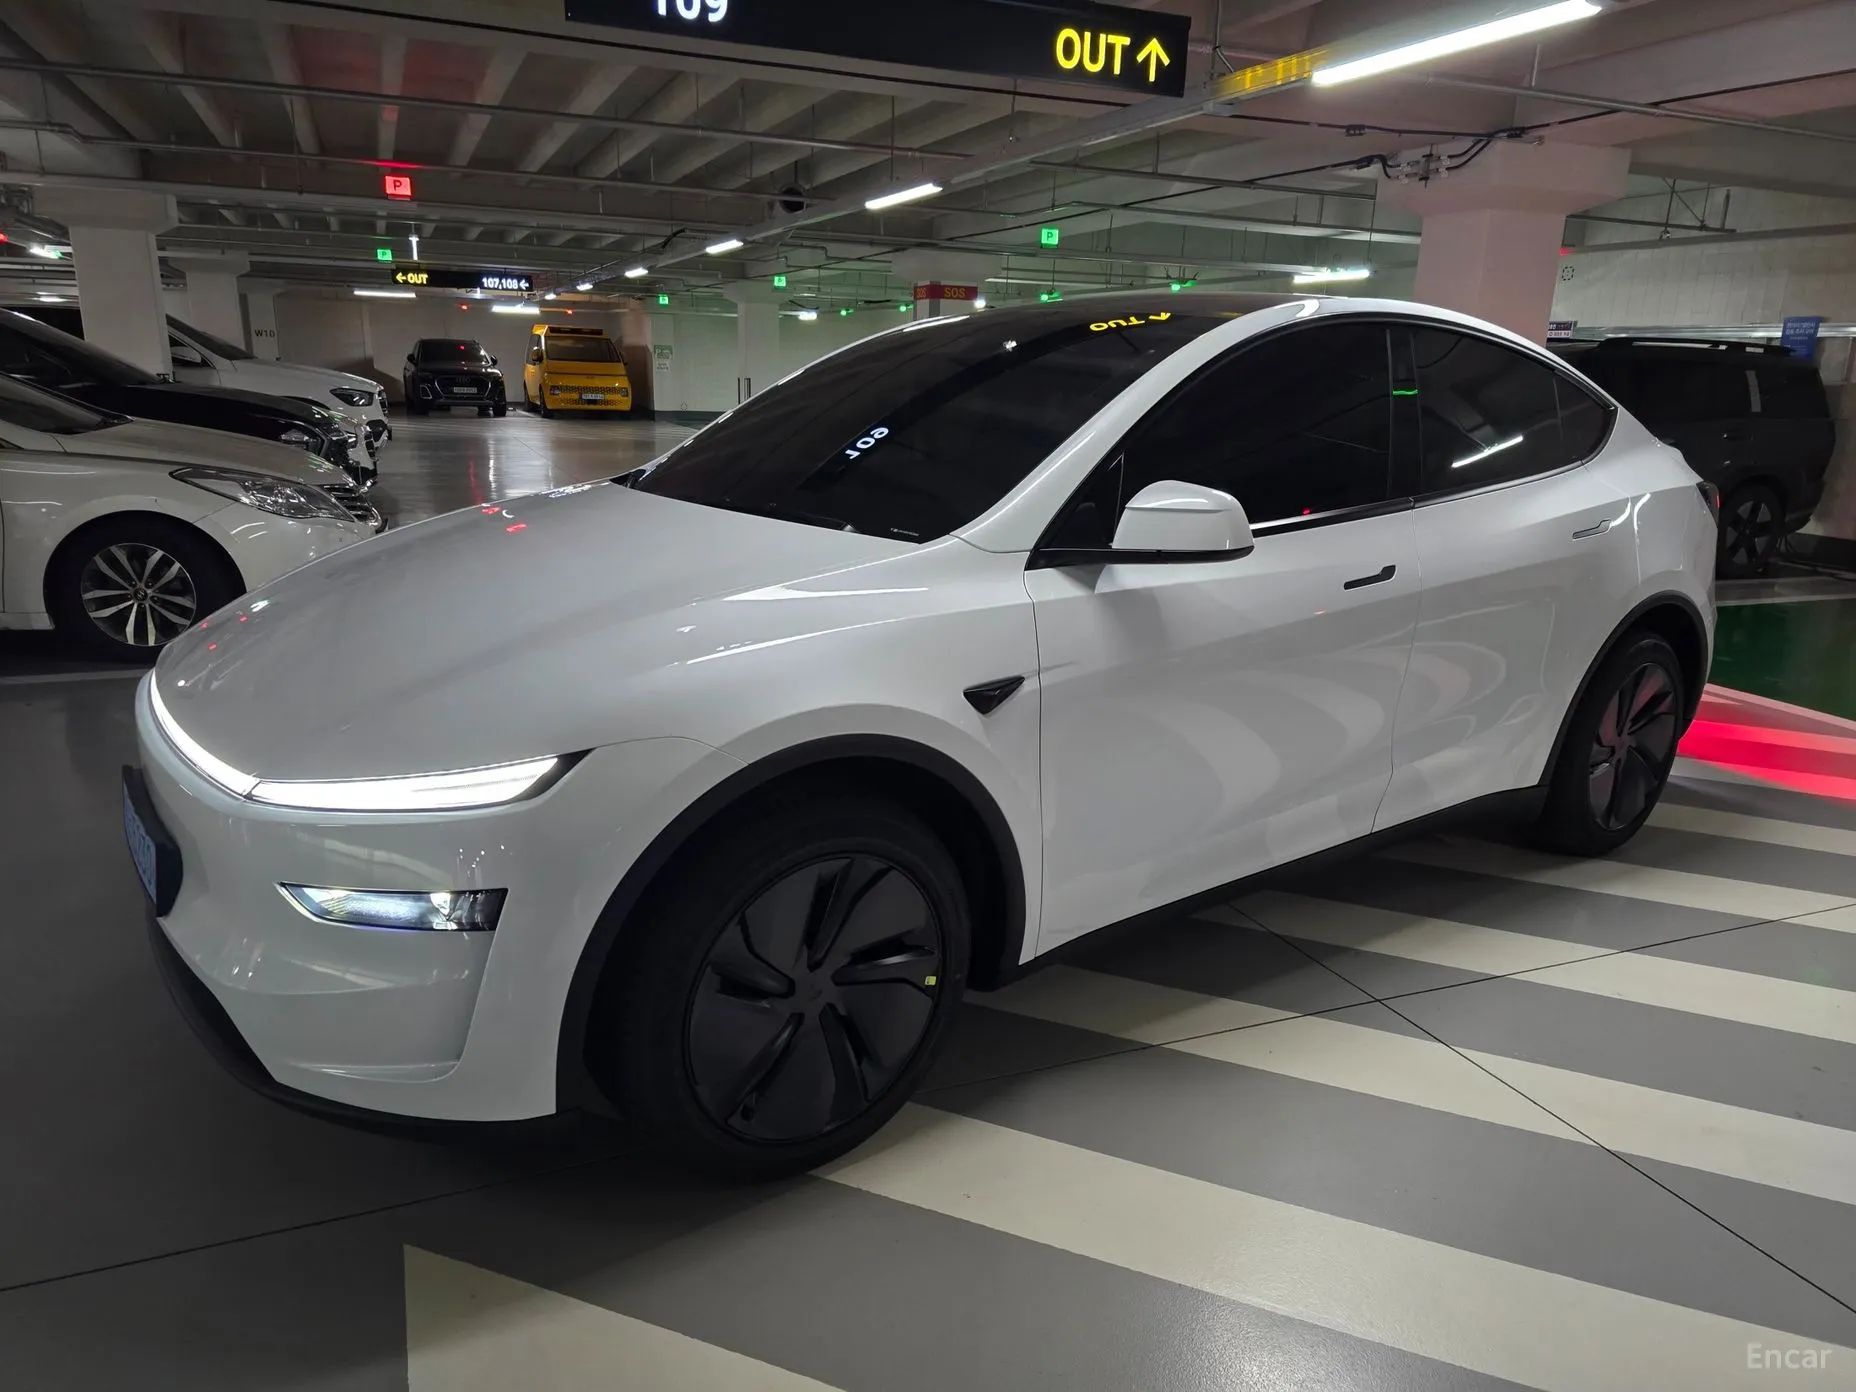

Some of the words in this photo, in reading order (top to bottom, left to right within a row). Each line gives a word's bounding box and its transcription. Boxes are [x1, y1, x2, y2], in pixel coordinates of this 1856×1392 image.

[1056, 28, 1131, 75] OUT
[393, 179, 402, 191] P
[407, 272, 428, 284] OUT
[482, 276, 518, 289] 107,108
[916, 287, 928, 298] SOS
[944, 287, 966, 298] SOS
